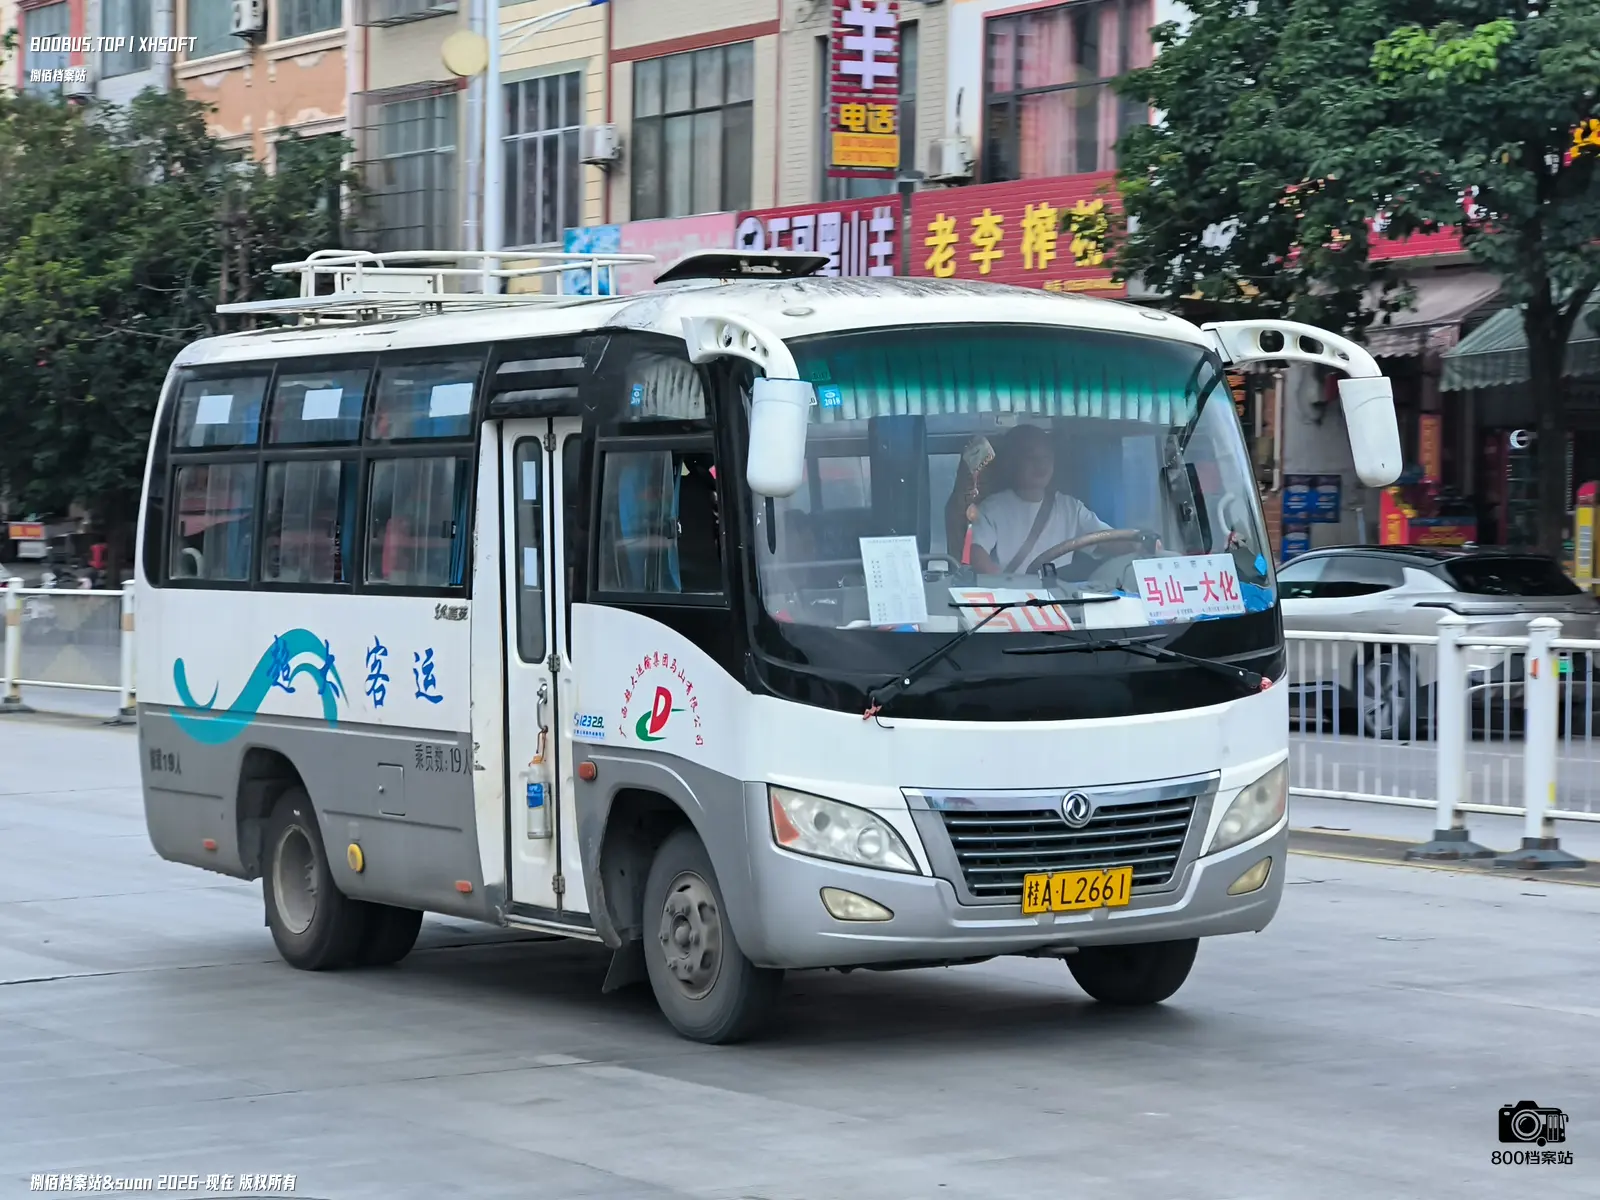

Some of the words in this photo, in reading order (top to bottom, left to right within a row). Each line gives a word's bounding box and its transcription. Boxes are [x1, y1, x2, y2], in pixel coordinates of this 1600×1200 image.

[840, 103, 895, 134] 电话
[266, 634, 444, 709] 超大客运
